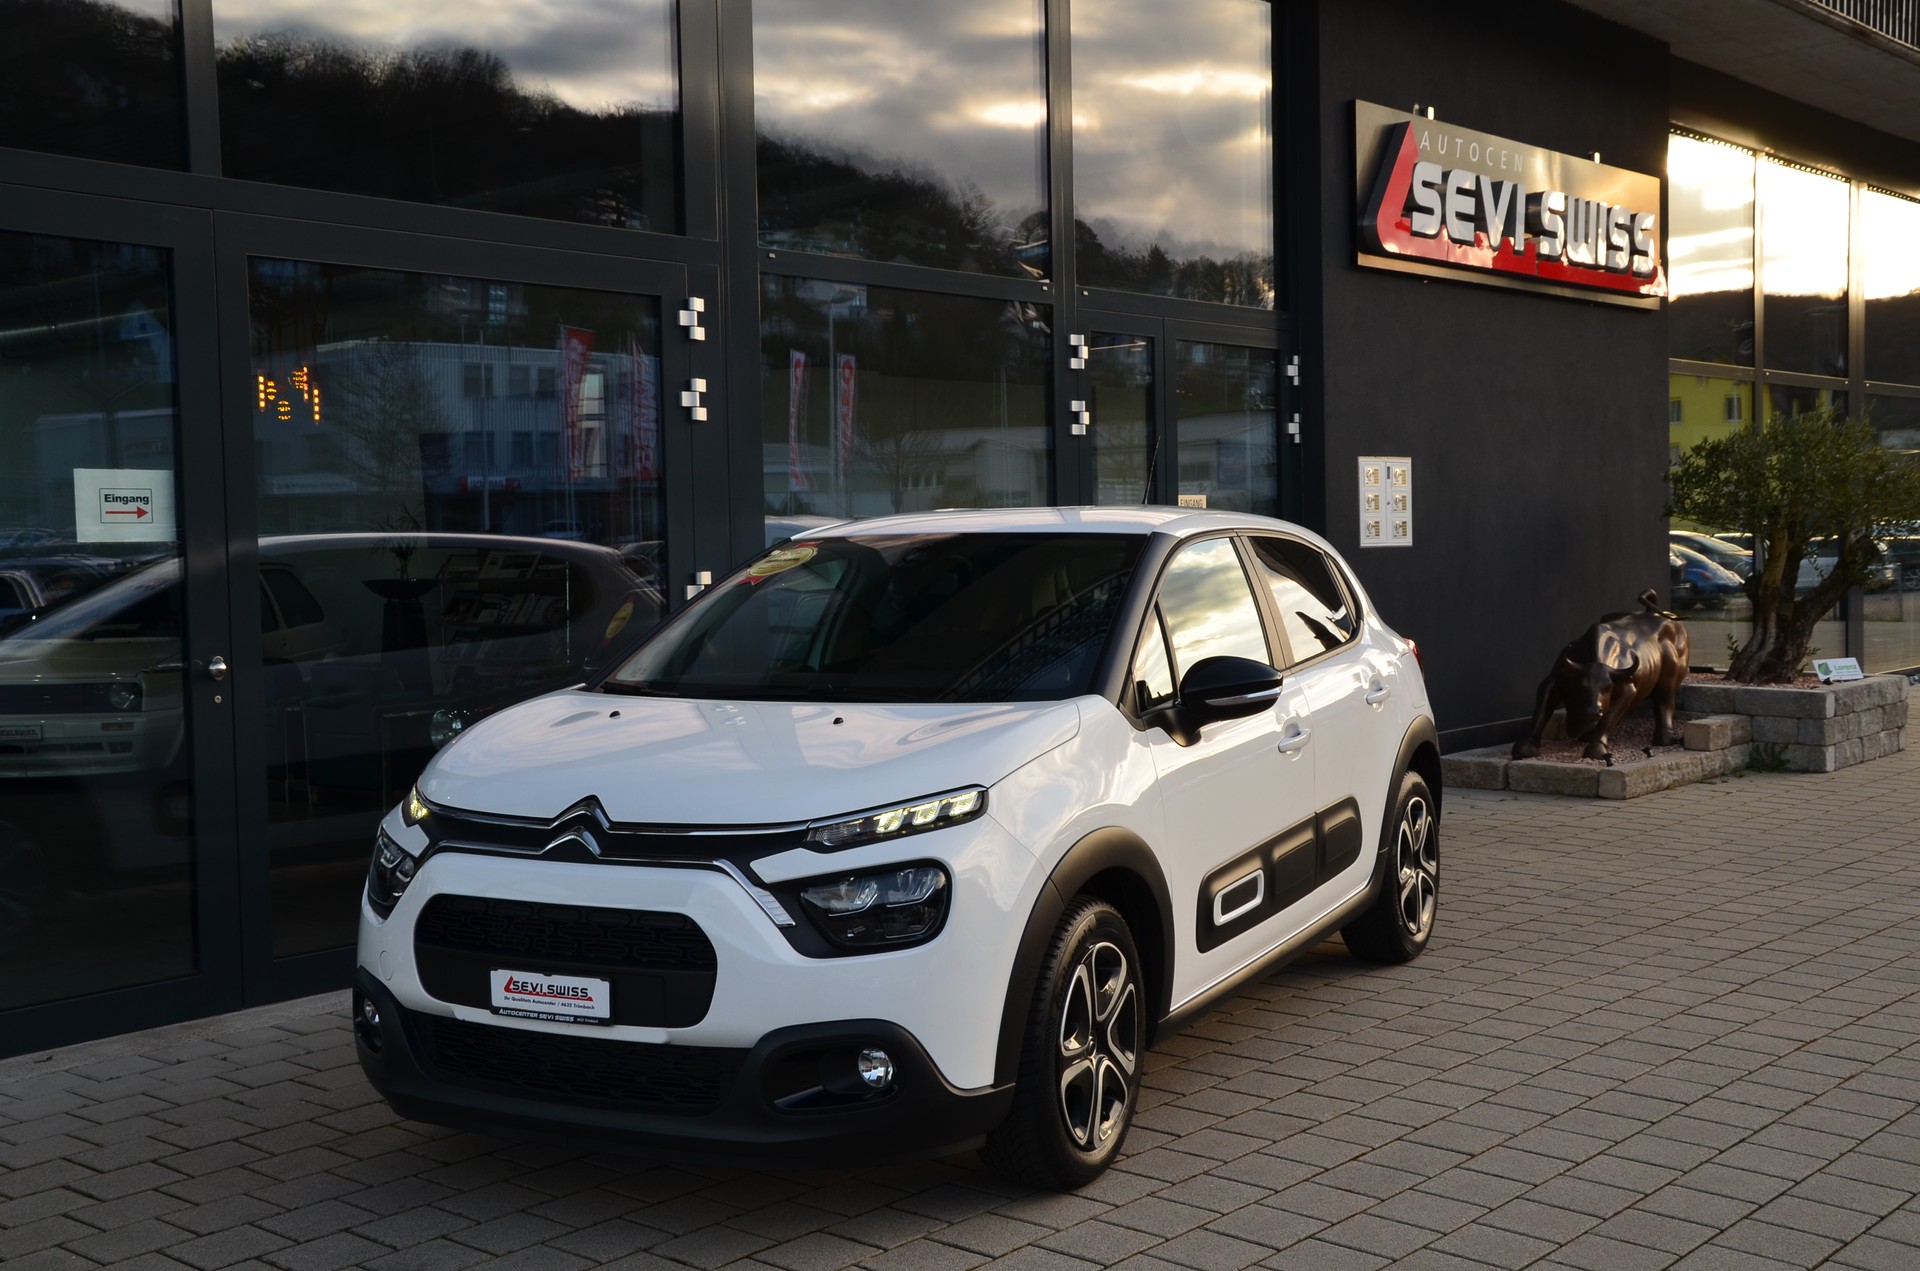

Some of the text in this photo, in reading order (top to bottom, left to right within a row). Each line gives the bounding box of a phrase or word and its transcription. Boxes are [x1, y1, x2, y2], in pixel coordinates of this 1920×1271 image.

[1419, 130, 1524, 173] AUTOCEN
[1410, 161, 1656, 276] SEVI SWISS
[104, 493, 150, 505] Eingang
[512, 980, 589, 998] SEVI SWISS
